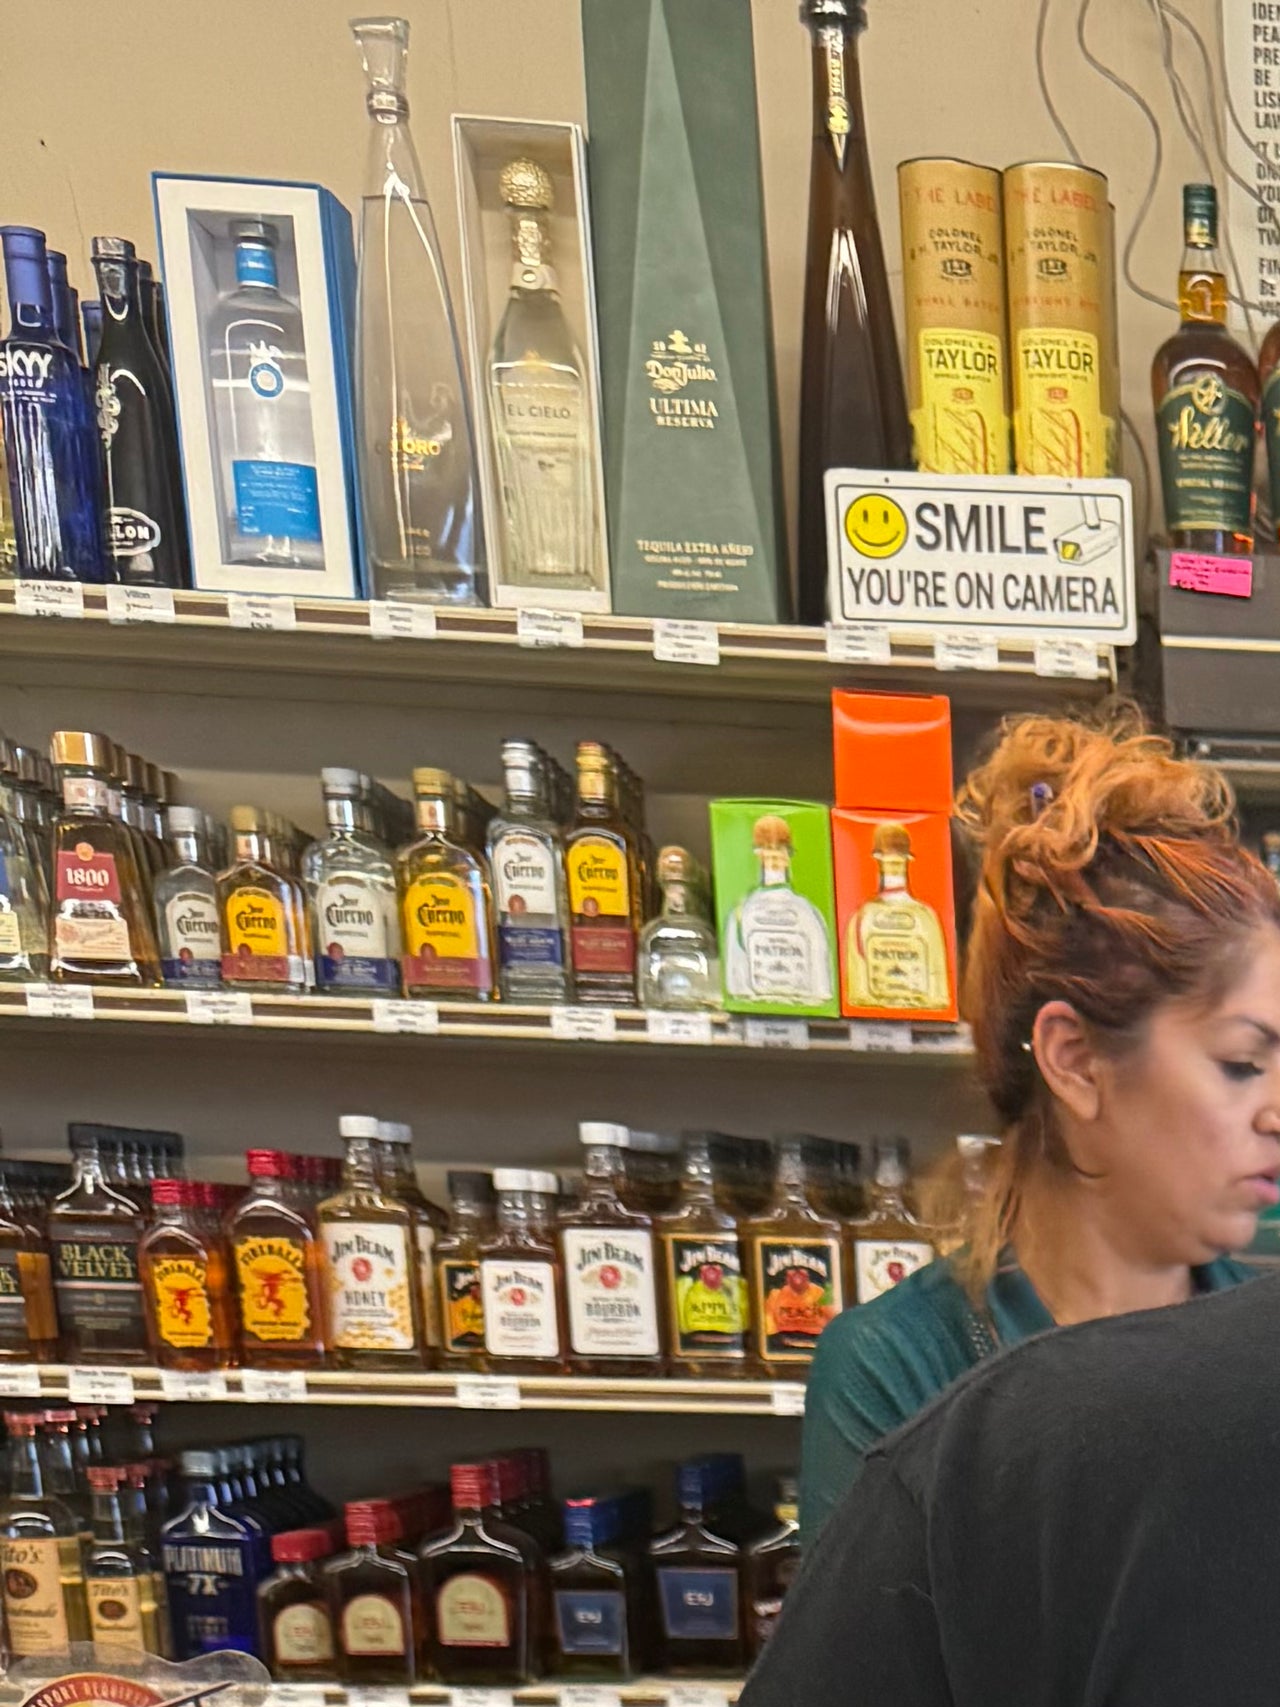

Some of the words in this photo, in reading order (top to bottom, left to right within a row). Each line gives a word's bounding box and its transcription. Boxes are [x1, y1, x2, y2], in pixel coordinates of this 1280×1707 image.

[1254, 68, 1272, 87] BE
[925, 349, 998, 375] TAYLOR
[1022, 349, 1094, 375] TAYLOR
[507, 405, 525, 417] EL
[528, 405, 571, 419] CIELO
[649, 397, 718, 418] ULTIMA
[655, 416, 714, 429] RESERVA
[915, 502, 1049, 555] SMILE
[637, 540, 681, 553] TEQUILA
[684, 542, 719, 555] EXTRA
[847, 567, 947, 608] YOU'RE
[955, 572, 995, 610] ON
[1003, 573, 1120, 615] CAMERA
[66, 867, 111, 888] 1800
[503, 860, 546, 881] Cuervo
[578, 862, 620, 882] Cuervo
[325, 907, 375, 929] Cuervo
[415, 904, 466, 928] Cuervo
[59, 1244, 128, 1263] BLACK
[331, 1238, 354, 1265] JIM
[354, 1234, 396, 1265] BEAM
[577, 1247, 601, 1271] JIM
[602, 1241, 645, 1272] BEAM
[58, 1259, 136, 1280] VELVET
[344, 1290, 386, 1308] HONEY
[584, 1301, 642, 1319] BOURBON
